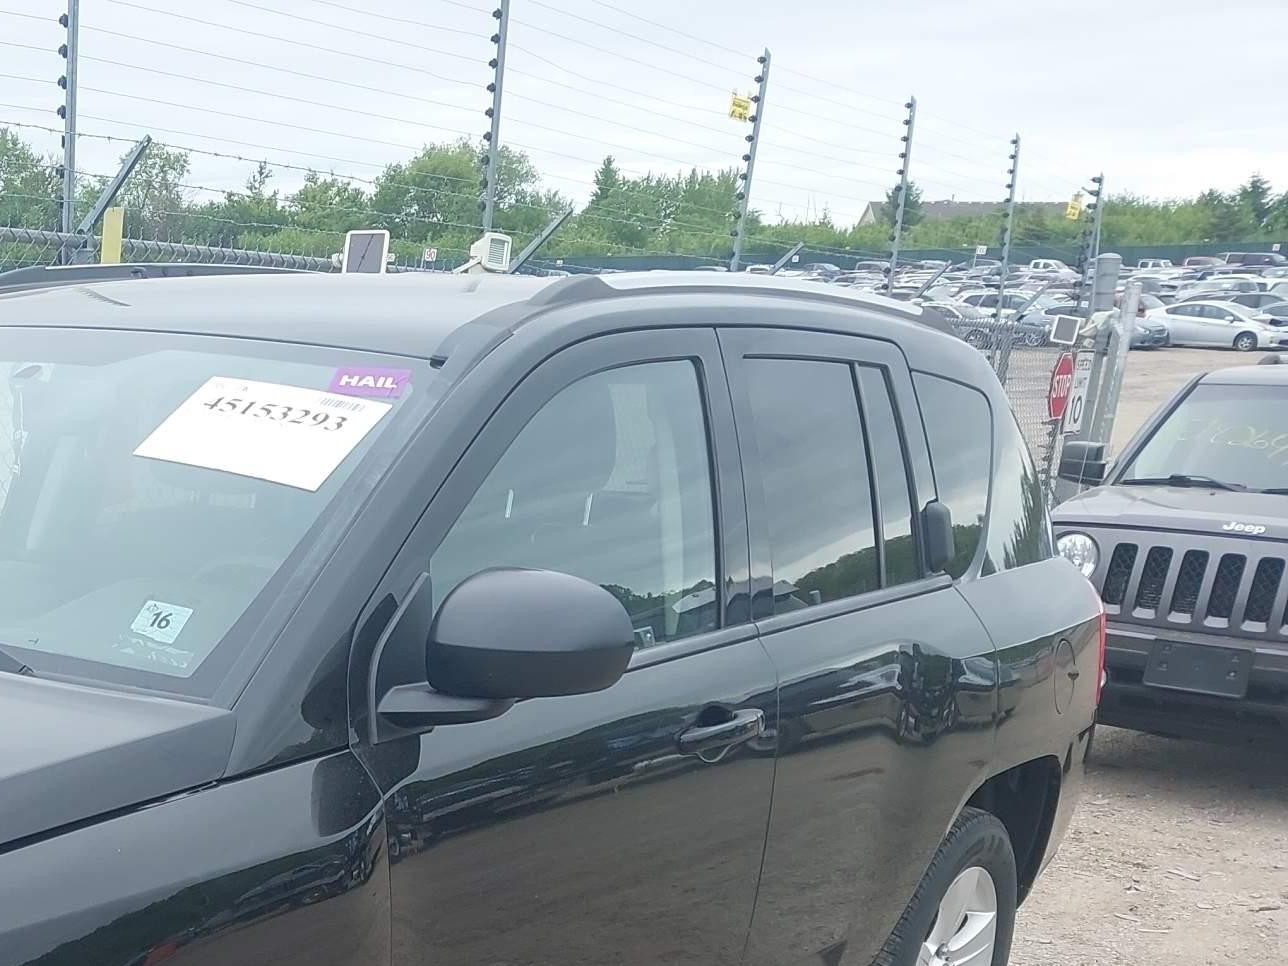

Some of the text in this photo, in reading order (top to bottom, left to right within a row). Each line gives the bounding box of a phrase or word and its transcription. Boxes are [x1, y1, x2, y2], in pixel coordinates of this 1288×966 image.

[339, 374, 398, 389] HAIL
[1052, 374, 1072, 399] STOP
[203, 396, 349, 432] 45153293
[1068, 395, 1083, 425] 10
[1222, 521, 1266, 535] Jeep
[150, 610, 173, 630] 16
